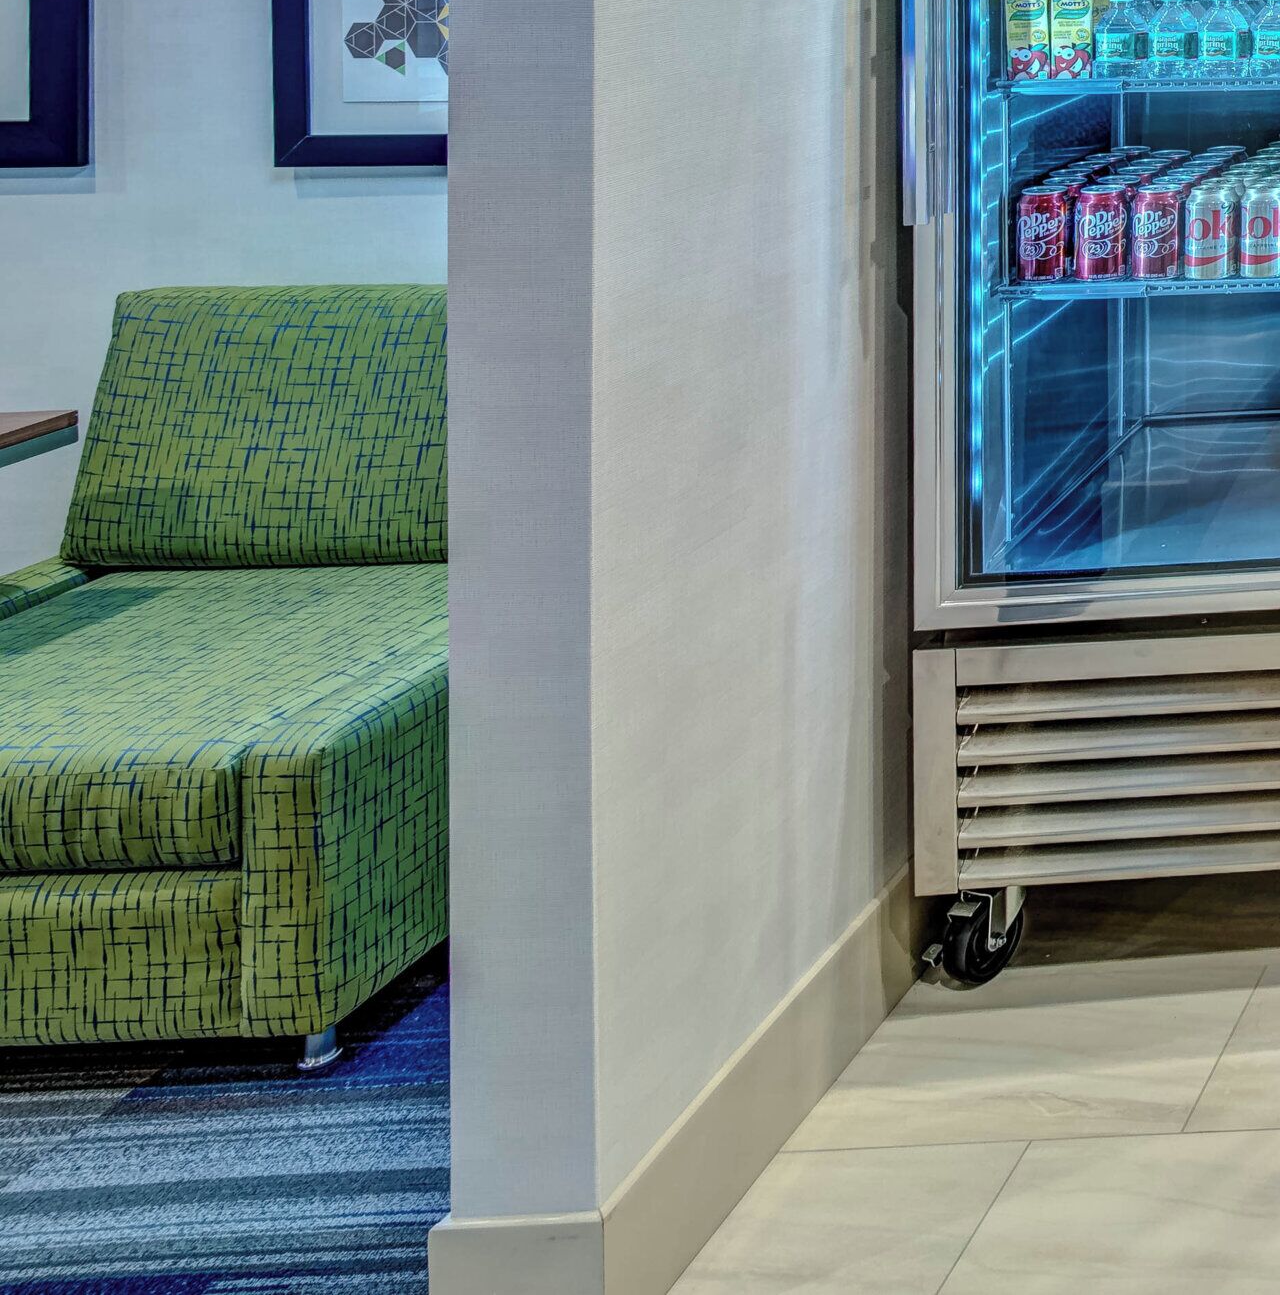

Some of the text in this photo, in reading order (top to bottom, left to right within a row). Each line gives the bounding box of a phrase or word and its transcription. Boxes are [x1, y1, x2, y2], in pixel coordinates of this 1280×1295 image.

[1030, 212, 1050, 226] Dr
[1099, 211, 1115, 224] Dr
[1134, 214, 1174, 237] Pepper
[1146, 210, 1163, 224] Dr
[1018, 216, 1062, 240] Pepper
[1083, 214, 1125, 239] Pepper
